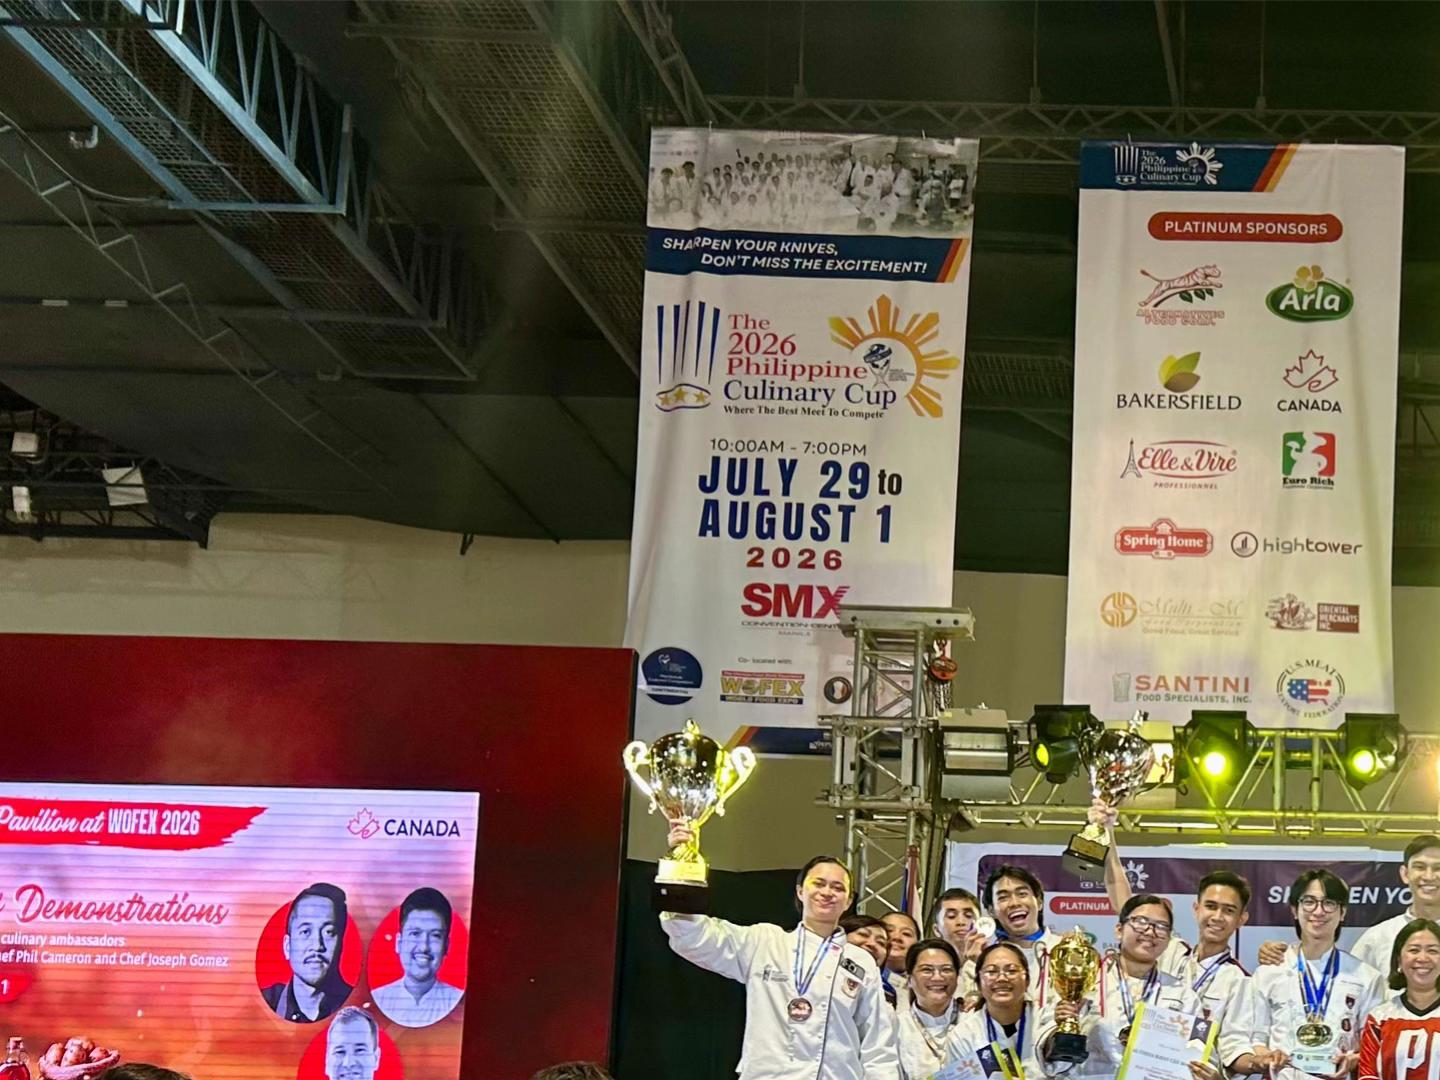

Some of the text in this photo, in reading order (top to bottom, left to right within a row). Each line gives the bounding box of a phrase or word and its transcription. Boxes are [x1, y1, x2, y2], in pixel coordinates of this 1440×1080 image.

[1164, 221, 1327, 236] PLATINUM SPONSORS
[662, 236, 838, 256] SHARPEN YOUR KNIVES,
[700, 253, 927, 274] DON'T MISS THE EXCITEMENT!
[1279, 286, 1341, 313] Arla
[728, 313, 770, 331] The
[727, 332, 797, 356] 2026
[726, 357, 868, 382] Philippine
[724, 380, 896, 409] Culinary Cup
[1117, 393, 1242, 411] BAKERSFIELD
[724, 405, 799, 416] Where Best
[1277, 399, 1342, 413] CANADA
[710, 438, 867, 456] 10:00AM 7:00PM
[698, 456, 902, 499] JULY 29 to
[1282, 477, 1334, 487] Euro Rich
[698, 499, 891, 543] AUGUST 1
[1123, 534, 1204, 548] Spring Home
[746, 547, 842, 570] 2026
[741, 583, 851, 619] SMX
[1136, 674, 1249, 693] SANTINI
[79, 808, 201, 836] at WOFEX 2026
[383, 818, 461, 839] CANADA
[14, 882, 230, 927] Demonstrations
[1060, 902, 1110, 910] PLATINUM
[49, 934, 125, 948] ambassadors
[16, 950, 229, 969] Phil Cameron and Chef Joseph Gomez
